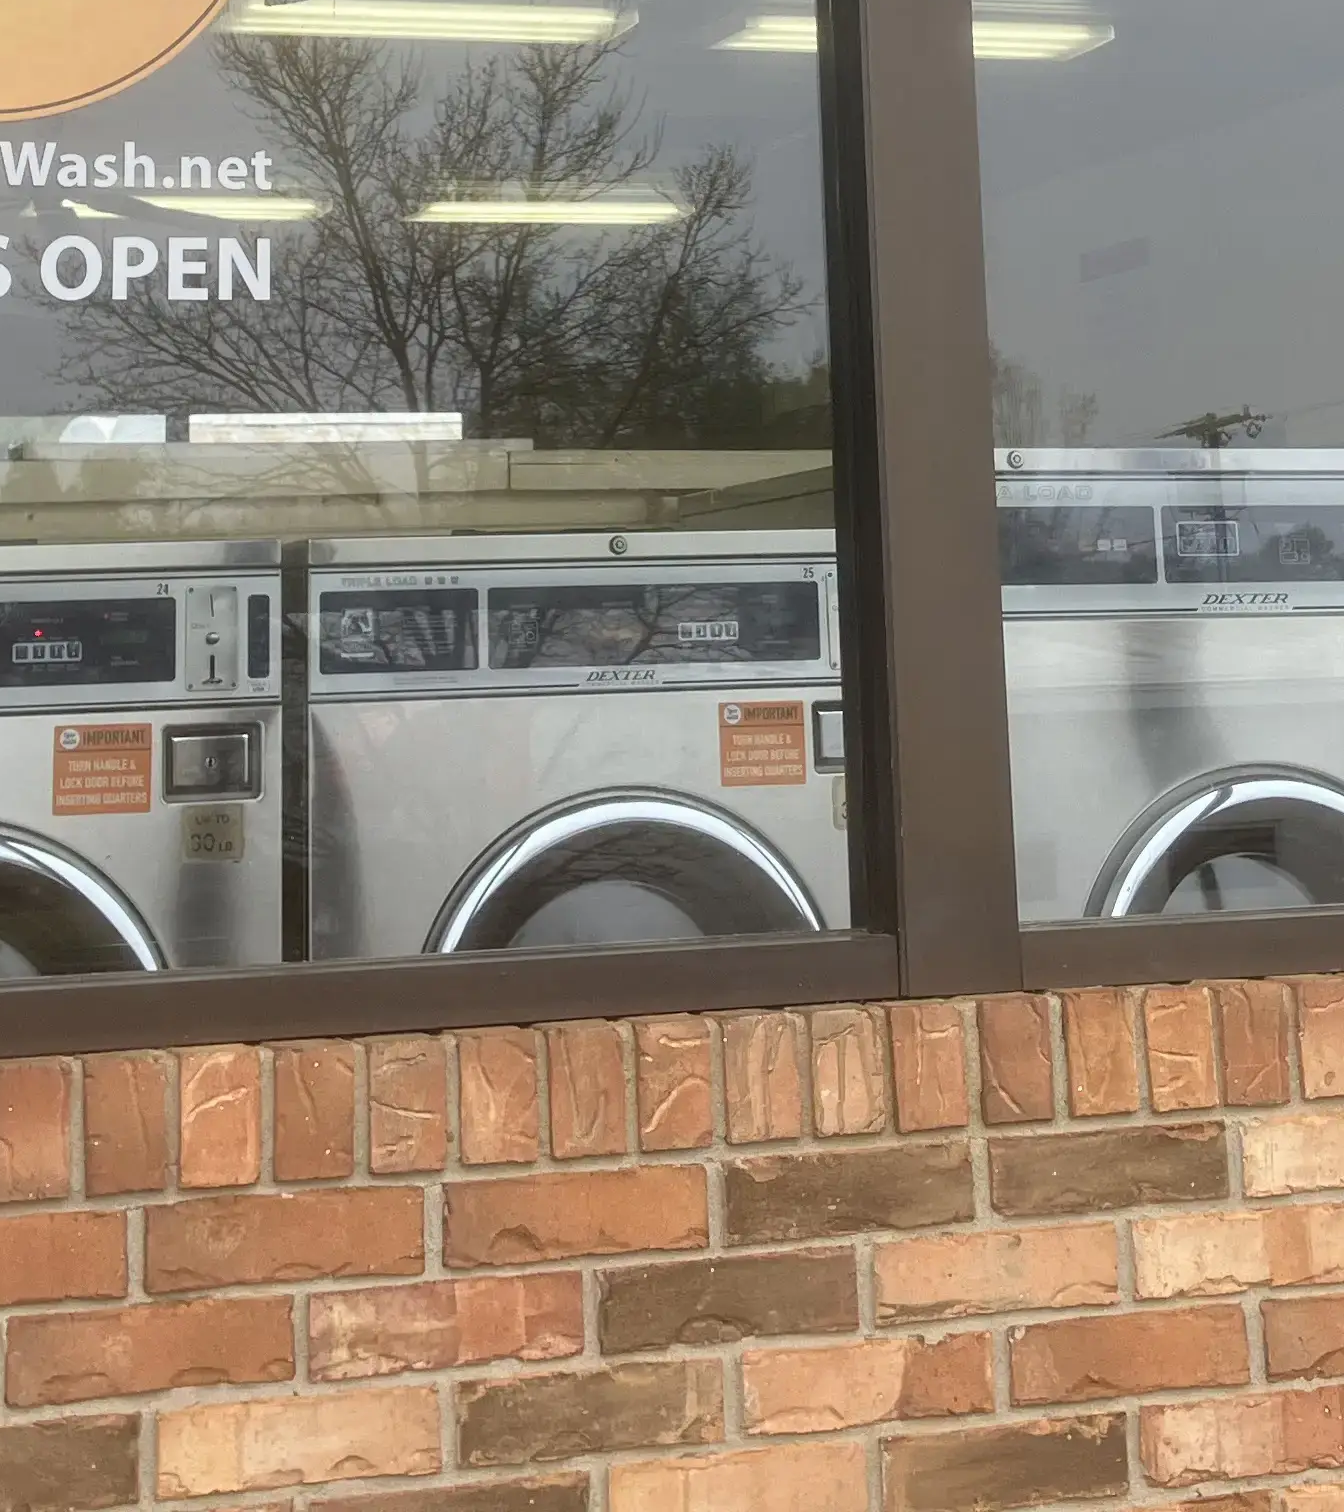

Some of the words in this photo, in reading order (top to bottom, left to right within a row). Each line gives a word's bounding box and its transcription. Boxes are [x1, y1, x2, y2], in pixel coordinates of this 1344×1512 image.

[40, 234, 273, 303] OPEN
[1024, 485, 1093, 501] LOAD
[803, 567, 815, 579] 25
[156, 583, 170, 596] 24
[1202, 592, 1289, 606] DEXTER
[585, 669, 657, 682] DEXTER
[82, 728, 146, 746] IMPORTANT
